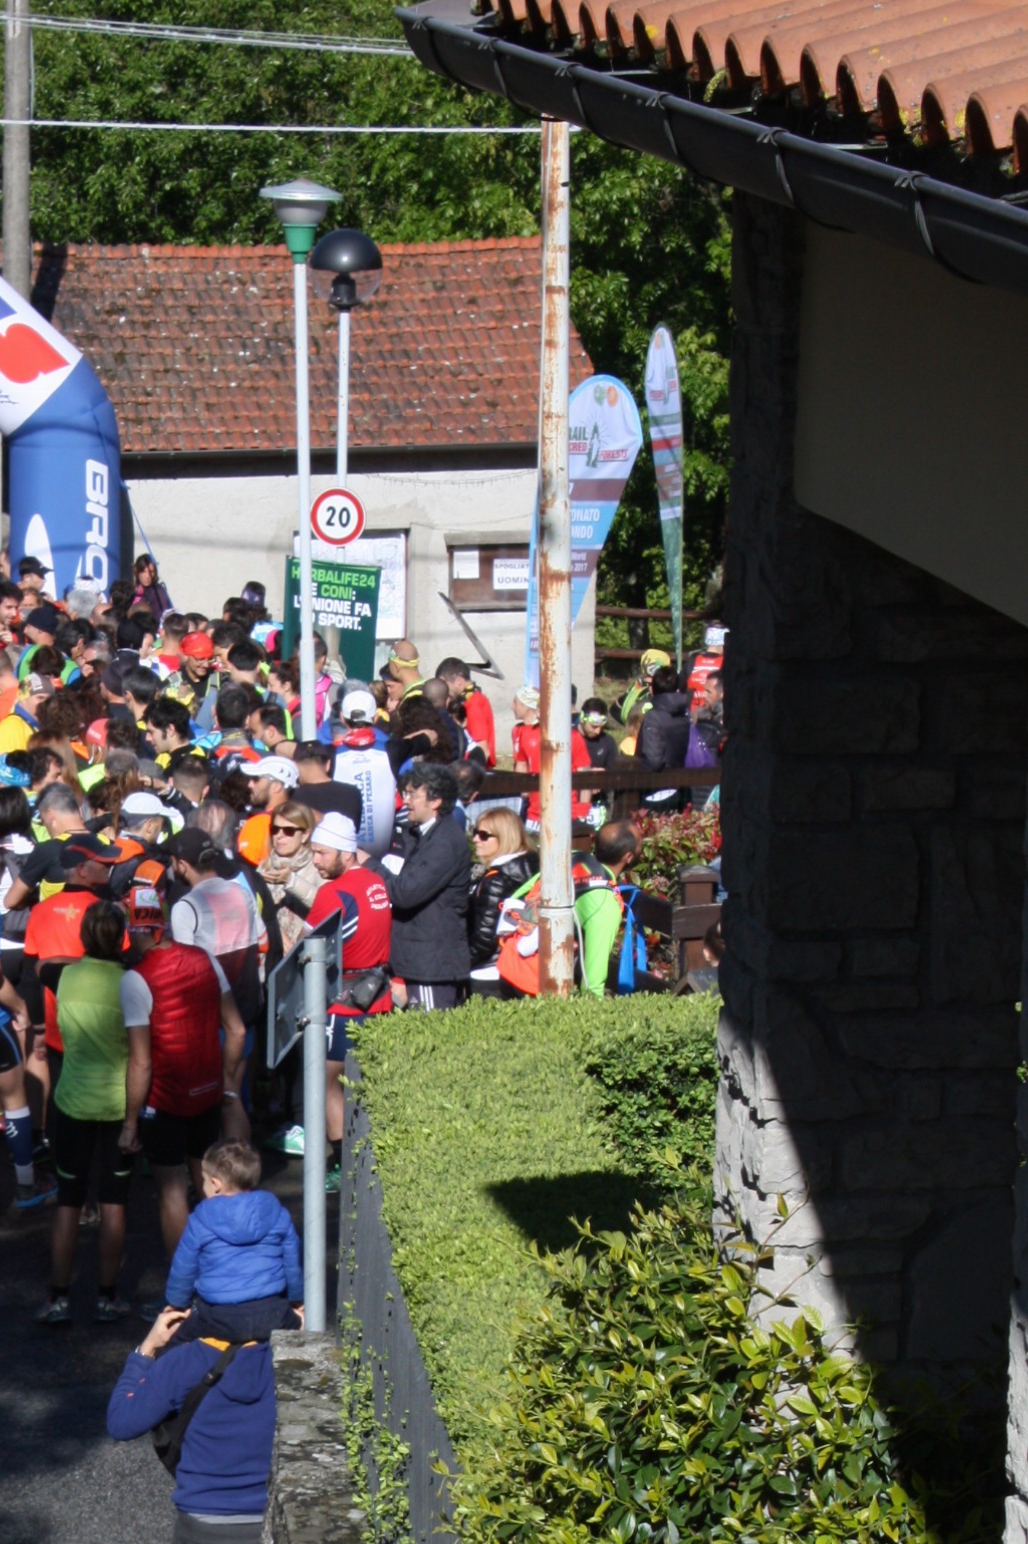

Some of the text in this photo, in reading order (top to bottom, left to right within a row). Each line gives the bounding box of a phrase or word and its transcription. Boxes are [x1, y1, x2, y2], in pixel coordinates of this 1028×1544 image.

[326, 506, 351, 529] 20
[86, 459, 109, 603] BRO
[292, 566, 376, 588] HRBALIFE24
[321, 584, 356, 601] CONI:
[294, 595, 372, 617] L'NIONE FA
[318, 612, 362, 631] SPORT.
